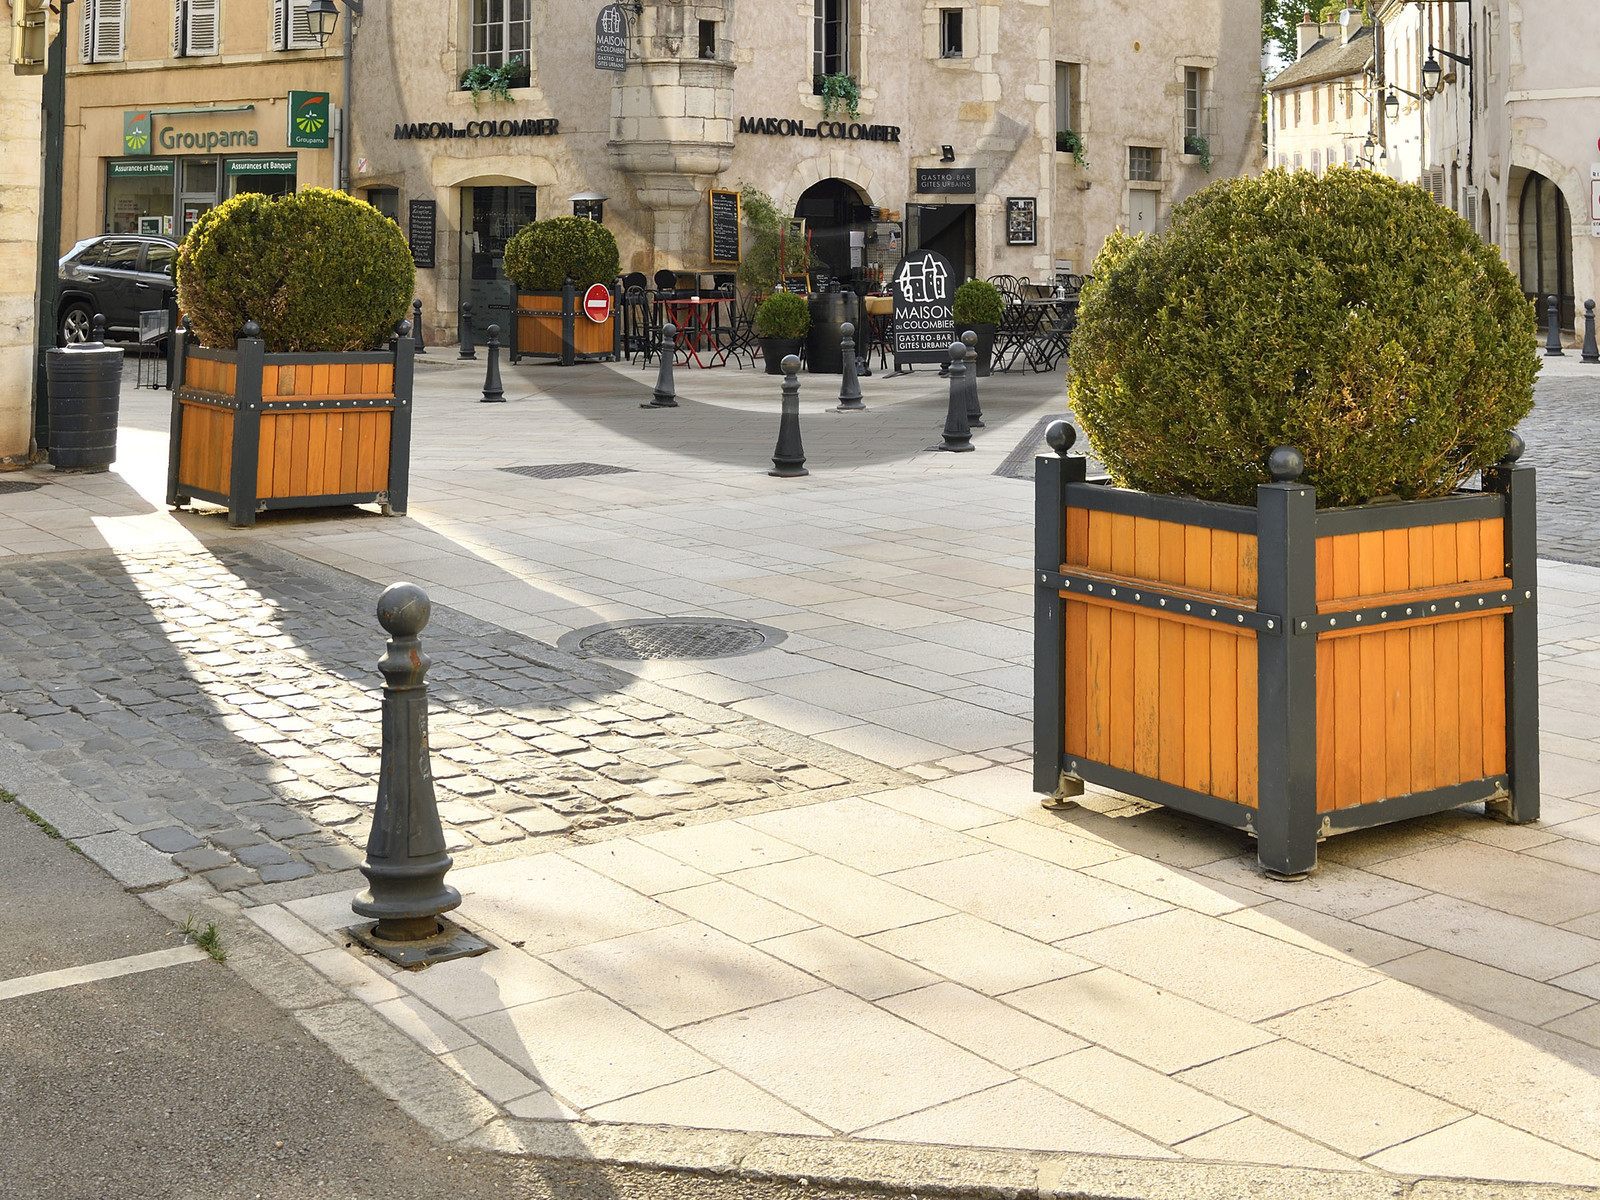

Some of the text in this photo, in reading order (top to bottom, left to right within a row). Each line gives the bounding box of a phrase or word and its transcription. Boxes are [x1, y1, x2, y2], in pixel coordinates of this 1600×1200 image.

[597, 35, 626, 47] MAISON
[600, 45, 626, 55] COLOMBIER
[394, 122, 453, 140] MAISON
[466, 118, 560, 138] COLOMBIER
[739, 116, 803, 136] MAISON
[817, 120, 901, 142] COLOMBIER
[159, 126, 258, 152] Groupama
[295, 136, 325, 144] Groupama
[115, 164, 142, 172] Assurances
[149, 164, 169, 172] Banque
[231, 161, 292, 171] Assurances et Banque
[1138, 211, 1143, 221] 5
[895, 305, 954, 319] MAISON
[903, 320, 954, 329] COLOMBIER
[899, 341, 952, 350] GITES URBAINS
